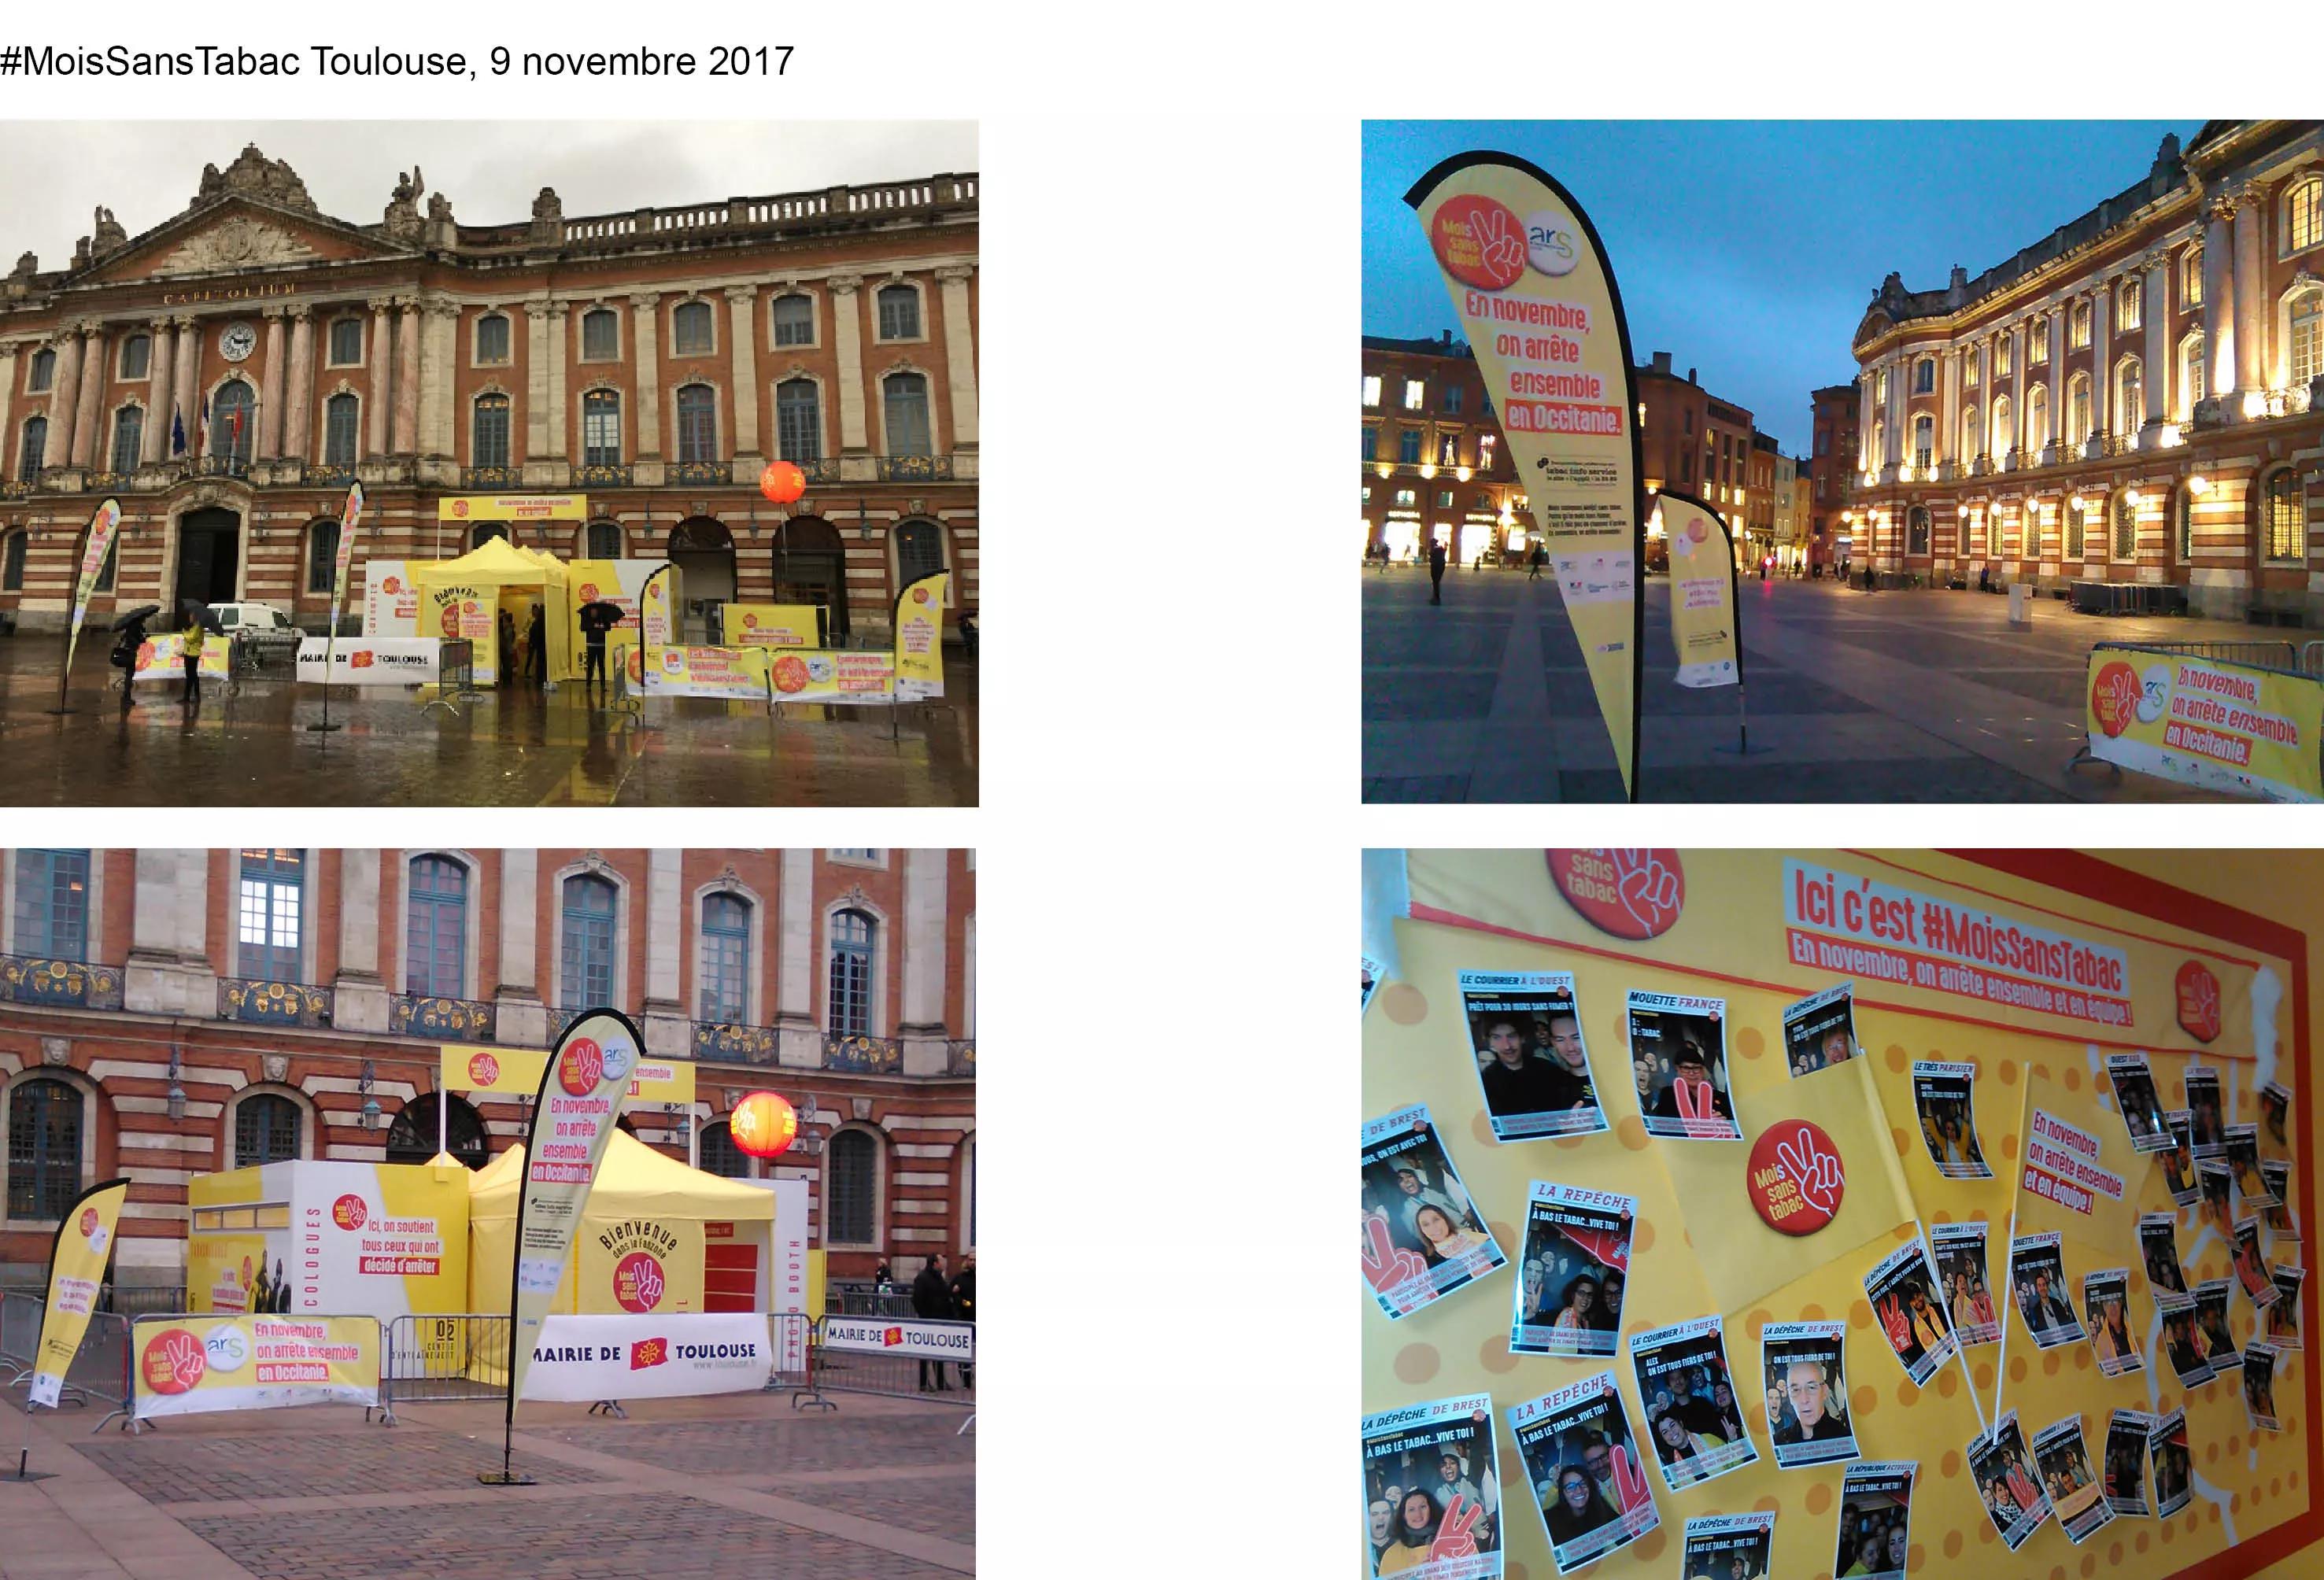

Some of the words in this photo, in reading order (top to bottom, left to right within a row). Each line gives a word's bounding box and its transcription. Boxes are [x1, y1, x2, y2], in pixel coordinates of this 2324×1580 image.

[1443, 217, 1472, 237] Mois
[1450, 237, 1479, 253] sans
[1529, 226, 1573, 257] ars
[1465, 290, 1489, 317] En
[1493, 297, 1591, 334] novembre,
[1497, 334, 1520, 356] on
[1526, 334, 1579, 363] arrête
[1510, 371, 1601, 399] ensemble
[1509, 404, 1530, 427] en
[1535, 404, 1621, 434] Occitanie.
[2191, 669, 2258, 706] novembre,
[2172, 696, 2185, 714] on
[2187, 699, 2226, 725] arrête
[2229, 709, 2299, 746] ensemble
[2167, 725, 2180, 744] en
[2182, 727, 2248, 765] Occitanie.
[1572, 854, 1613, 881] sans
[1566, 872, 1617, 904] tabac
[1796, 869, 1835, 928] Ici
[1843, 878, 1916, 945] c'est
[1923, 903, 2122, 992] #MoisSansTabac
[1461, 975, 1472, 984] LE
[1474, 976, 1520, 985] COURRIER
[1793, 932, 1817, 965] En
[1820, 940, 1913, 988] novembre,
[1916, 960, 1936, 983] on
[1939, 963, 1984, 993] arrête
[1987, 975, 2052, 1010] ensemble
[2056, 990, 2069, 1015] et
[2071, 995, 2085, 1015] en
[1629, 991, 1677, 1006] MOUETTE
[1678, 998, 1723, 1010] FRANCE
[604, 1047, 627, 1066] ars
[635, 1069, 671, 1079] ensemble
[551, 1098, 562, 1114] En
[562, 1098, 610, 1116] novembre,
[556, 1121, 567, 1135] on
[570, 1120, 597, 1137] arrête
[1370, 1122, 1385, 1135] DE
[1389, 1108, 1425, 1128] BREST
[2034, 1111, 2046, 1134] En
[2048, 1120, 2097, 1162] novembre,
[543, 1144, 586, 1159] ensemble
[533, 1168, 544, 1180] en
[546, 1165, 591, 1183] Occitanie.
[1754, 1163, 1786, 1189] Mois
[2029, 1143, 2043, 1162] on
[2045, 1150, 2075, 1176] arrête
[2076, 1164, 2123, 1197] ensemble
[1537, 1184, 1556, 1196] LA
[1767, 1179, 1797, 1202] sans
[2025, 1171, 2037, 1191] et
[2038, 1176, 2050, 1197] en
[1539, 1210, 1554, 1221] BAS
[1555, 1214, 1562, 1223] LE
[1769, 1195, 1804, 1221] tabac
[384, 1223, 394, 1233] on
[397, 1220, 434, 1234] soutient
[600, 1221, 677, 1250] Bienvenue
[305, 1208, 320, 1307] COLOGUES
[362, 1239, 382, 1252] tous
[384, 1241, 405, 1253] ceux
[408, 1241, 423, 1255] qui
[424, 1242, 439, 1253] ont
[613, 1242, 630, 1259] dans
[630, 1239, 637, 1249] la
[365, 1257, 395, 1272] décidé
[789, 1240, 800, 1293] BOOTH
[255, 1323, 268, 1338] En
[271, 1323, 326, 1340] novembre,
[788, 1306, 799, 1358] PHOTO
[828, 1327, 866, 1341] MAIRIE
[869, 1331, 882, 1342] DE
[906, 1331, 969, 1349] TOULOUSE
[1643, 1328, 1678, 1343] COURRIER
[1687, 1319, 1720, 1332] L'OUEST
[1774, 1325, 1805, 1335] DÉPÊCHE
[208, 1338, 243, 1359] ars
[257, 1345, 272, 1359] on
[275, 1341, 305, 1359] arrête
[309, 1344, 358, 1360] ensemble
[600, 1346, 621, 1360] DE
[676, 1344, 756, 1359] TOULOUSE
[258, 1368, 272, 1382] en
[275, 1366, 328, 1381] Occitanie.
[1517, 1404, 1535, 1421] LA
[1543, 1374, 1608, 1411] REPÊCHE
[1362, 1419, 1373, 1430] LA
[1376, 1408, 1427, 1427] DÉPÊCHE
[1432, 1404, 1448, 1416] DE
[1452, 1397, 1488, 1412] BREST
[1366, 1445, 1373, 1459] À
[1374, 1443, 1391, 1456] BAS
[1394, 1441, 1403, 1452] LE
[1734, 1516, 1745, 1525] DE
[1747, 1515, 1772, 1524] BREST
